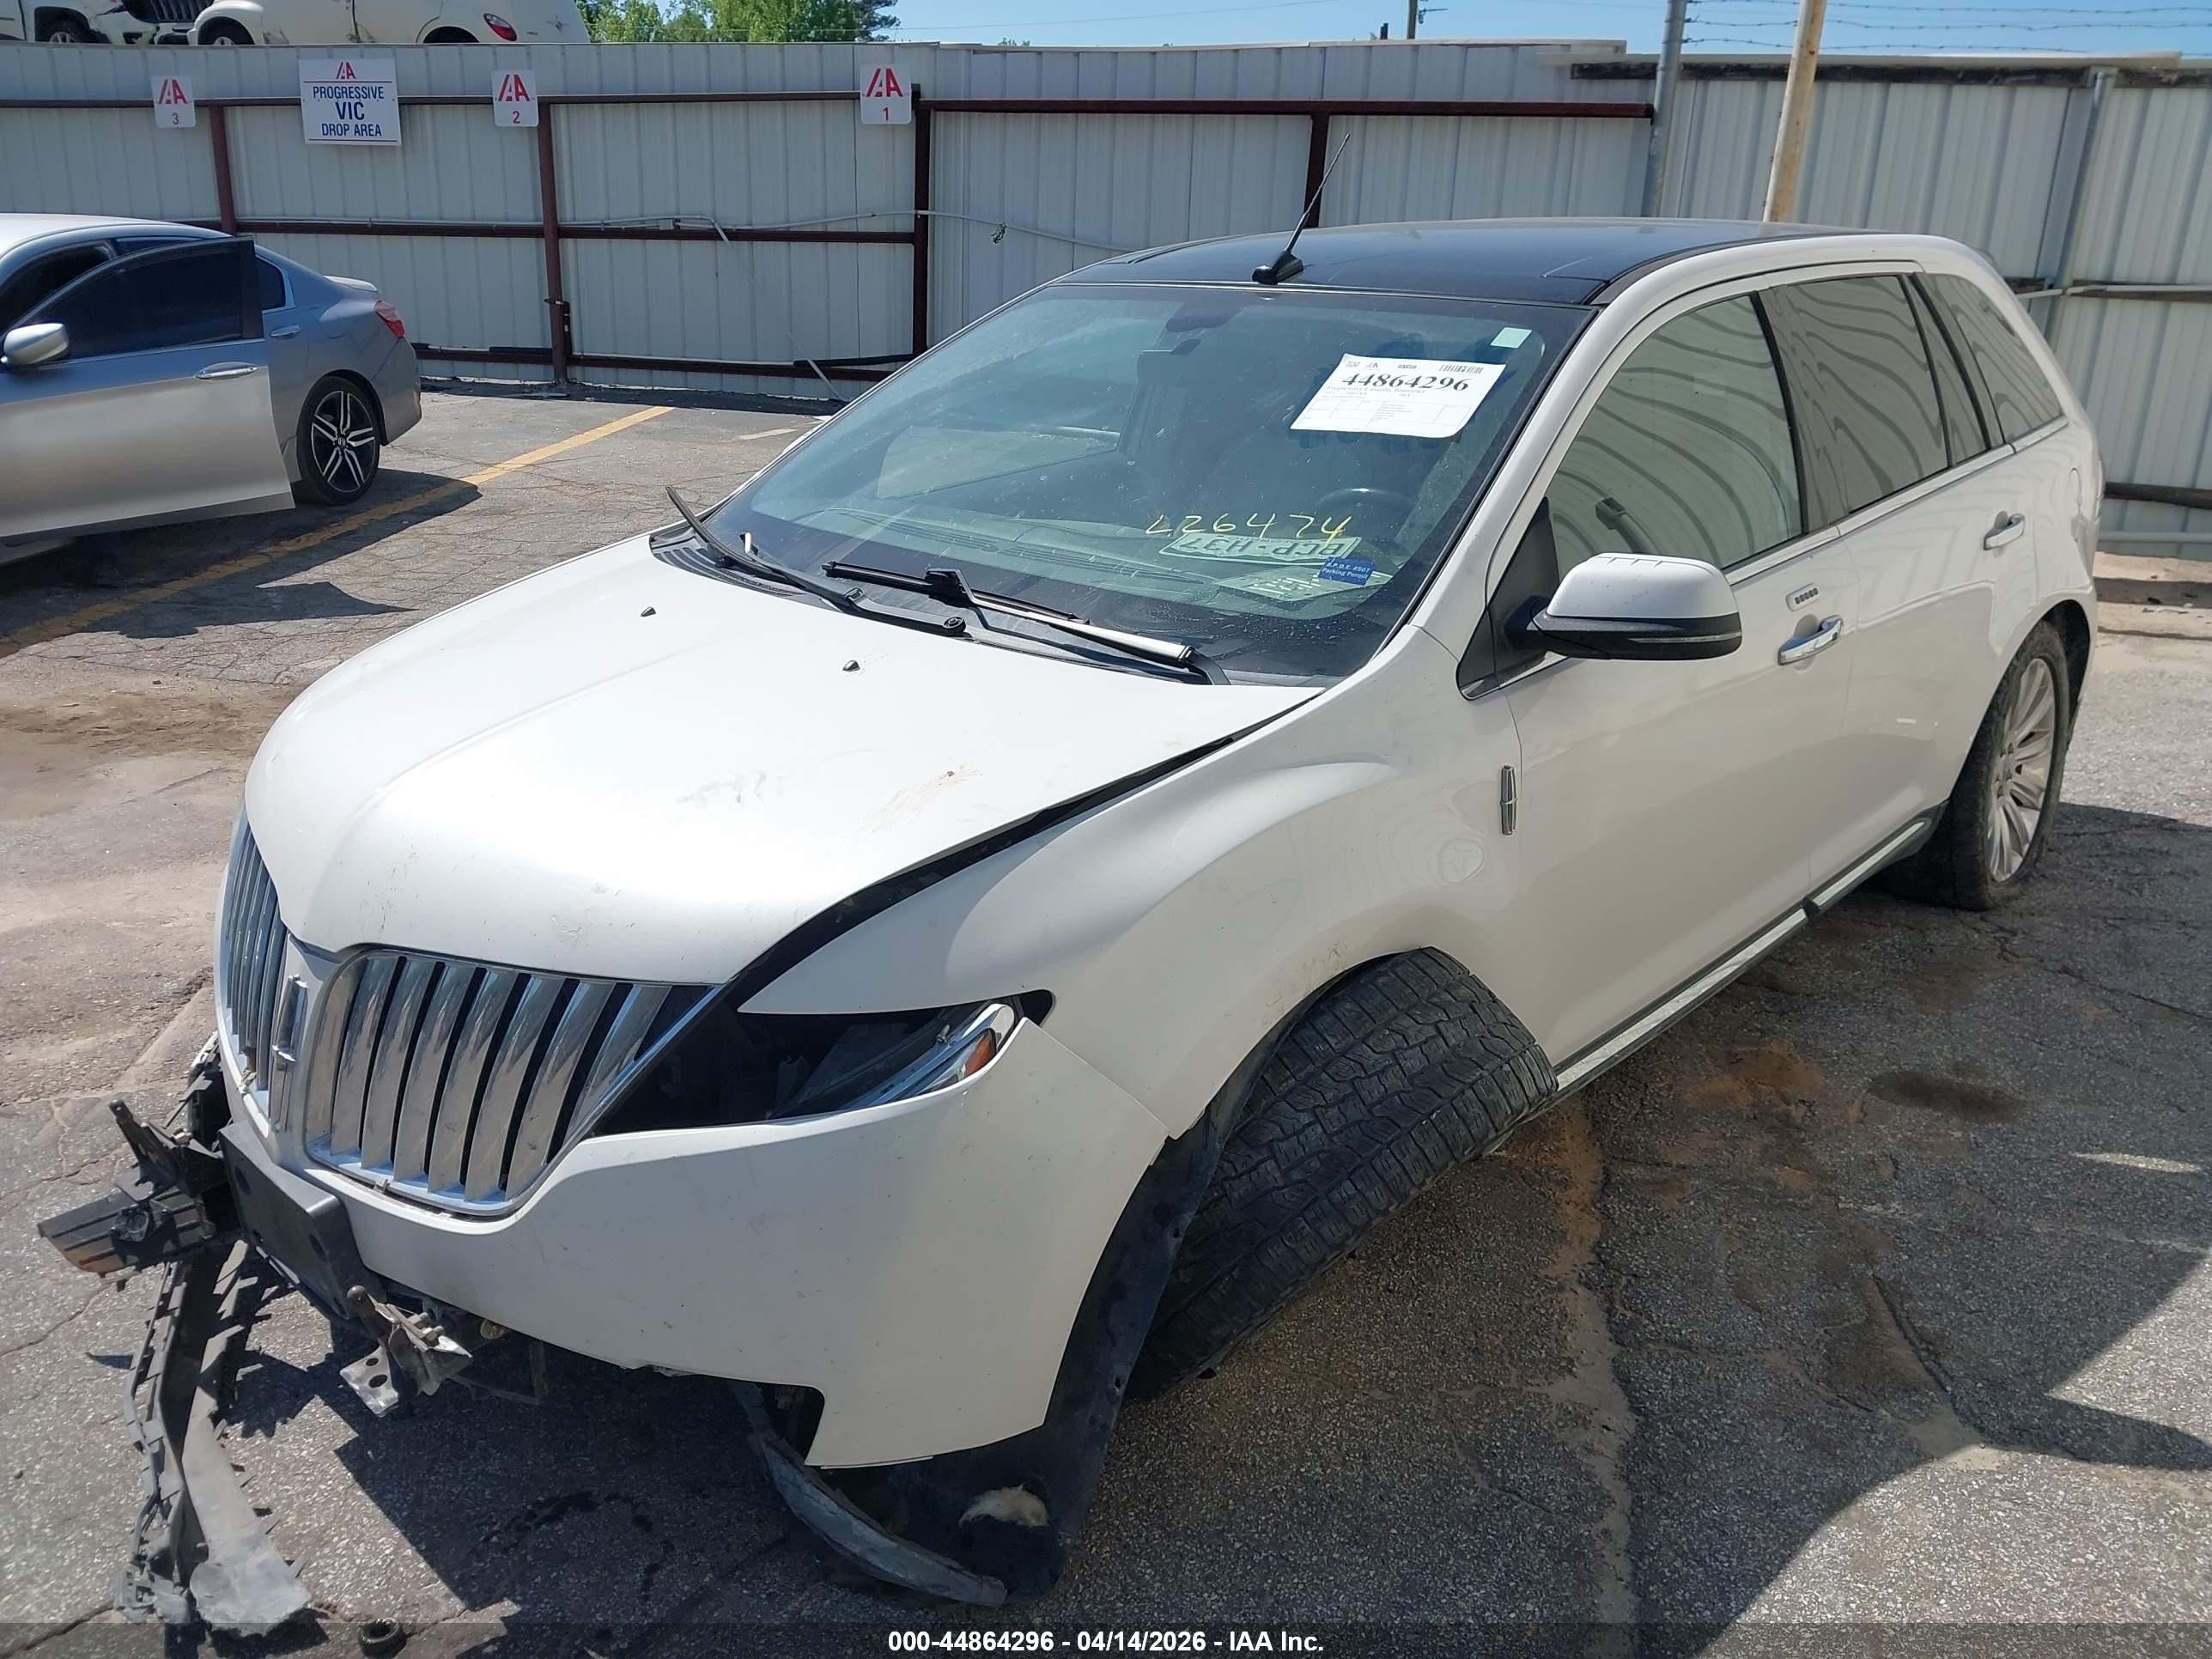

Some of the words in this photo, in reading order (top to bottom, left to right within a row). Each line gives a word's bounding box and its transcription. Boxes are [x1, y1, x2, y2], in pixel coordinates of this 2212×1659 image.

[313, 86, 385, 100] PROGRESSIVE
[335, 101, 365, 120] VIC
[512, 111, 520, 124] 2
[883, 106, 889, 121] 1
[172, 112, 179, 125] 3
[321, 123, 350, 137] DROP
[354, 124, 383, 137] AREA
[1341, 373, 1474, 392] 44864296
[1322, 567, 1347, 576] Parking
[1346, 570, 1369, 580] Permit
